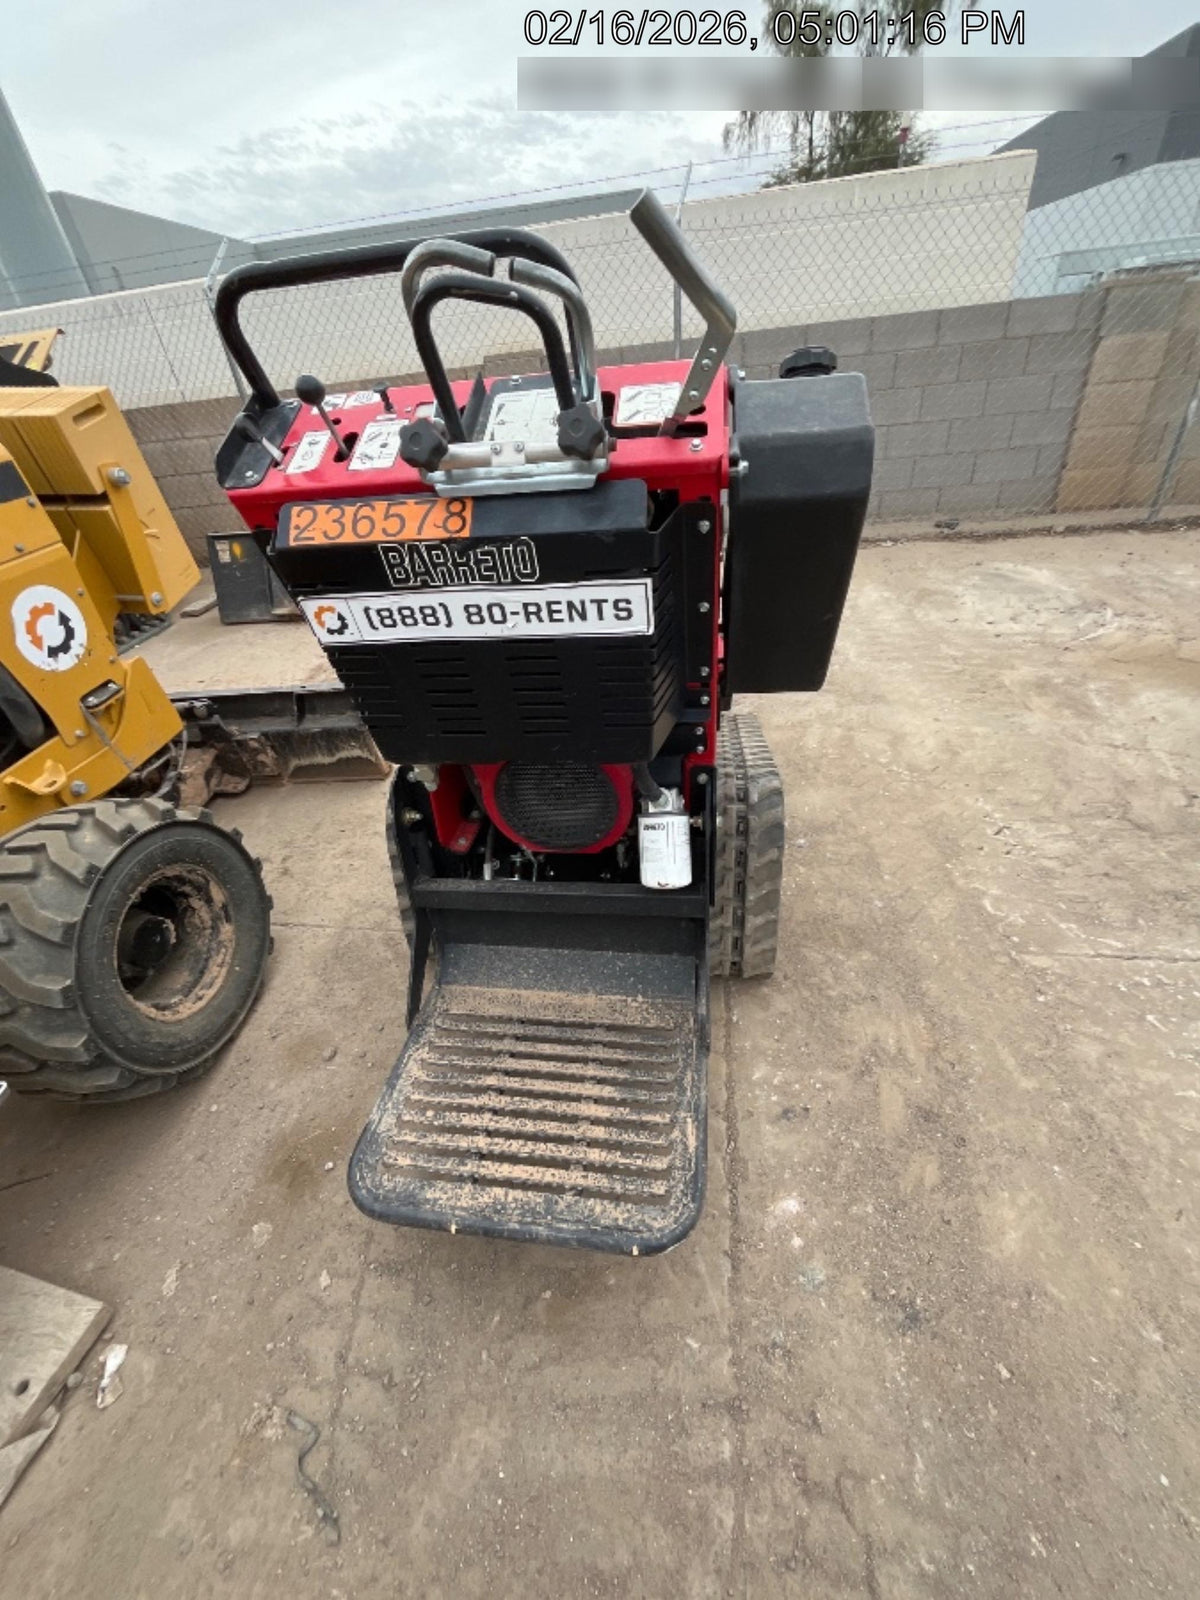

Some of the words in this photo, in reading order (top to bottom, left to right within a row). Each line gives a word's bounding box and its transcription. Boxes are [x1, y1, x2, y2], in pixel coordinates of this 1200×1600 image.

[292, 498, 468, 542] 236578
[363, 602, 453, 629] (888)
[463, 598, 634, 626] 80-RENTS
